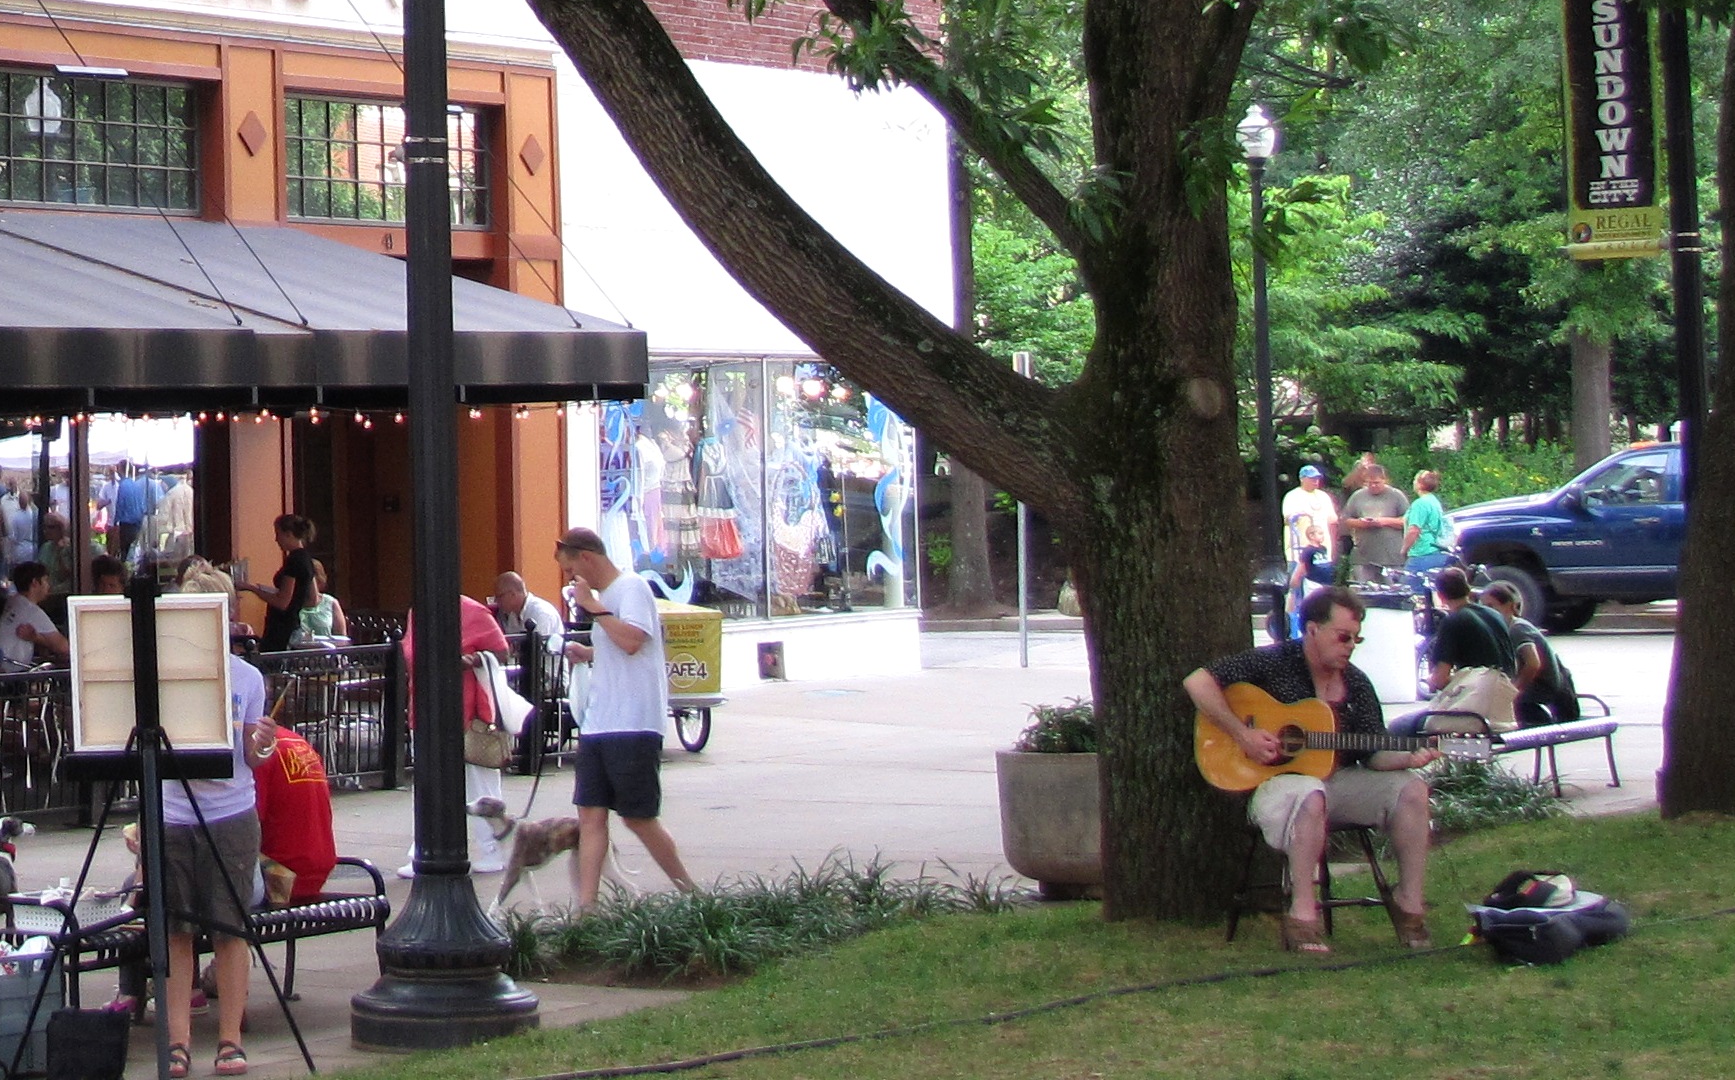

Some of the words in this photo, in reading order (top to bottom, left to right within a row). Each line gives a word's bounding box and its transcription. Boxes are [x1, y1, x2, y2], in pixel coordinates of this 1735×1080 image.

[1609, 178, 1640, 190] THE
[1588, 188, 1640, 204] CITY
[1595, 213, 1653, 230] REGAL
